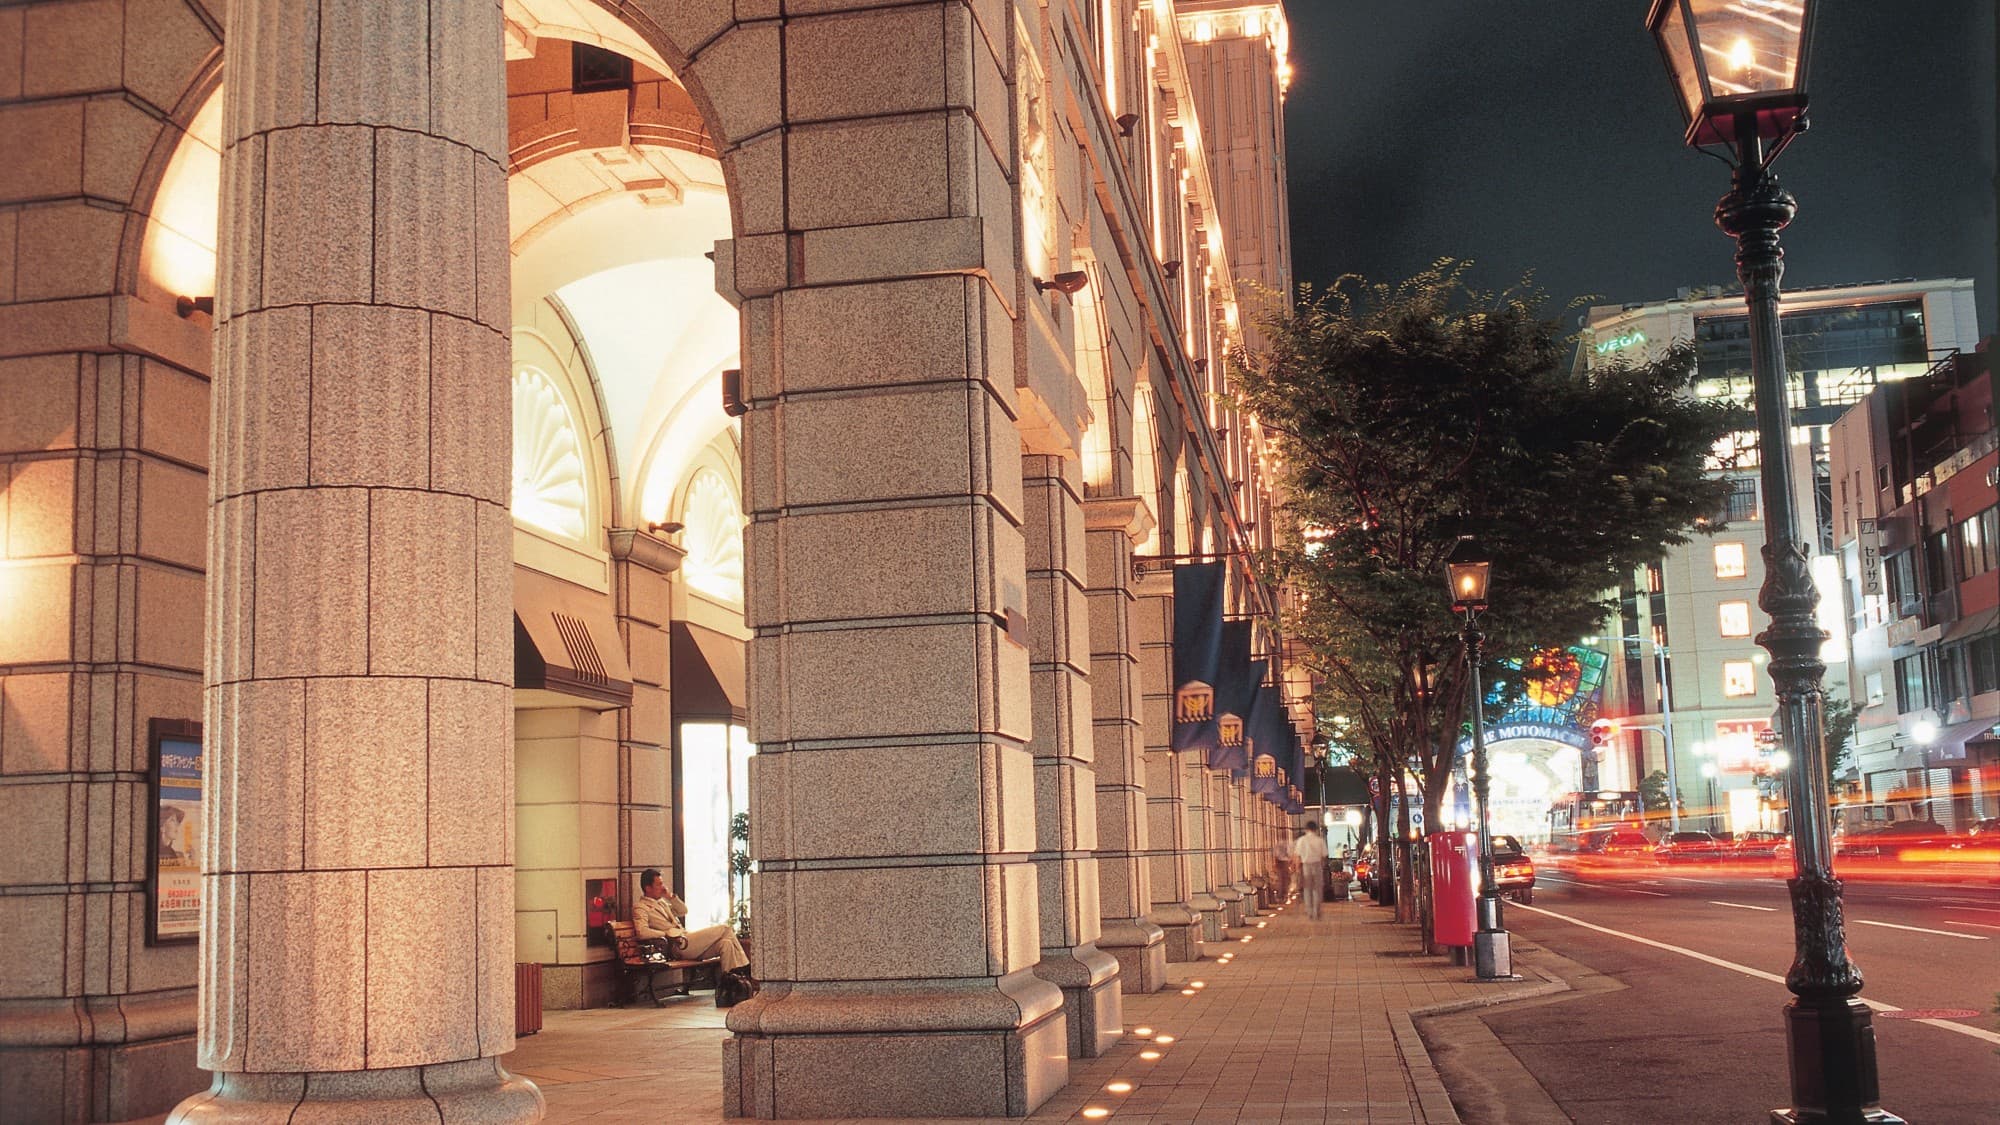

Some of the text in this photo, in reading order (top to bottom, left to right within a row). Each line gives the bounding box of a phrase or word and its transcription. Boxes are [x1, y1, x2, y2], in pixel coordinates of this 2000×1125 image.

[1595, 332, 1645, 353] VEGA
[1864, 546, 1878, 593] セリザワ
